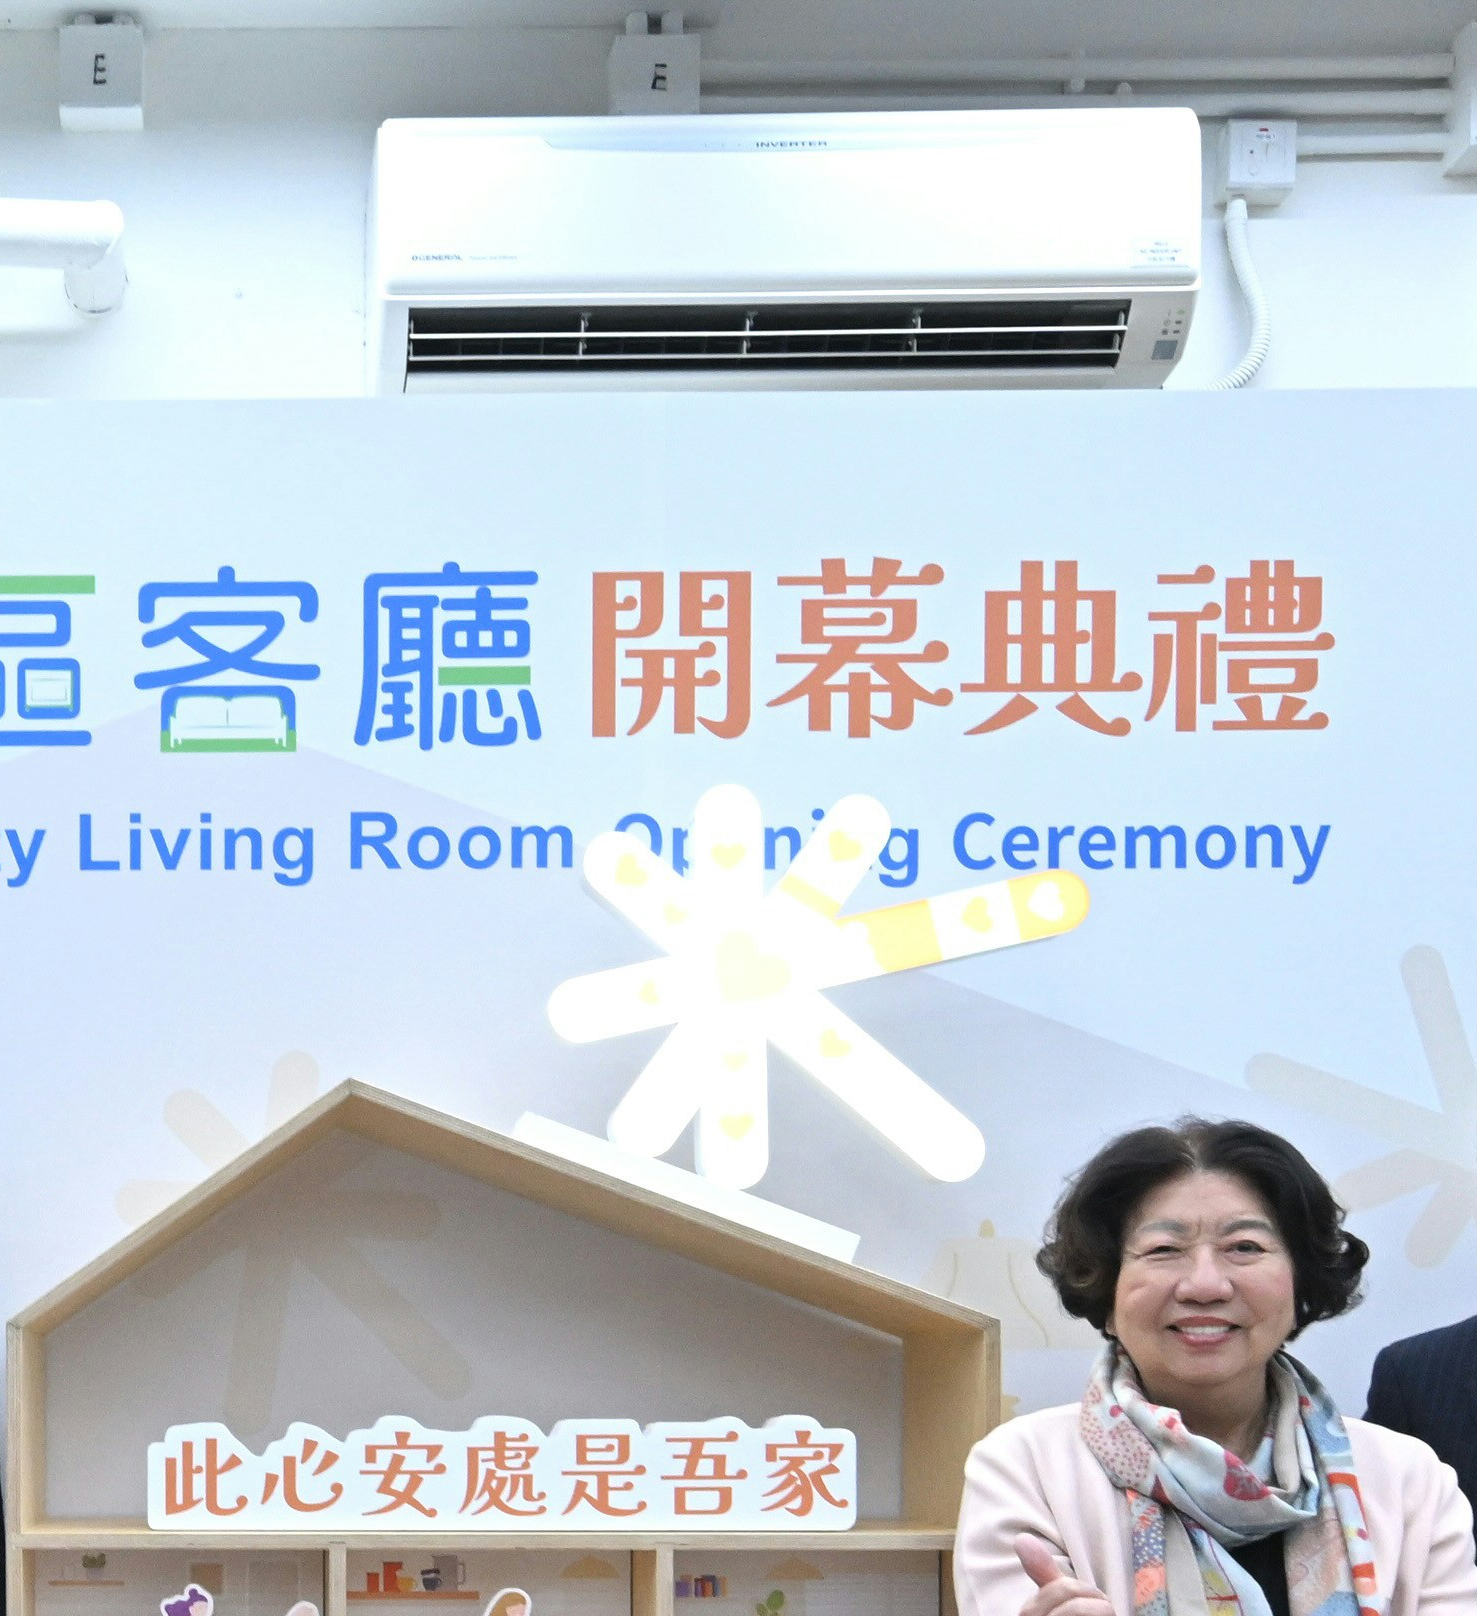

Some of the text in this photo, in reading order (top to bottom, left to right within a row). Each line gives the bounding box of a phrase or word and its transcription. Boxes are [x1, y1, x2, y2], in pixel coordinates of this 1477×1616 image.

[93, 54, 106, 85] E
[651, 64, 667, 90] E
[755, 140, 827, 148] INVERTER
[80, 813, 313, 886] Living
[350, 812, 573, 870] Room
[953, 813, 1331, 892] Ceremony
[165, 1430, 849, 1517] 此心安處是吾家
